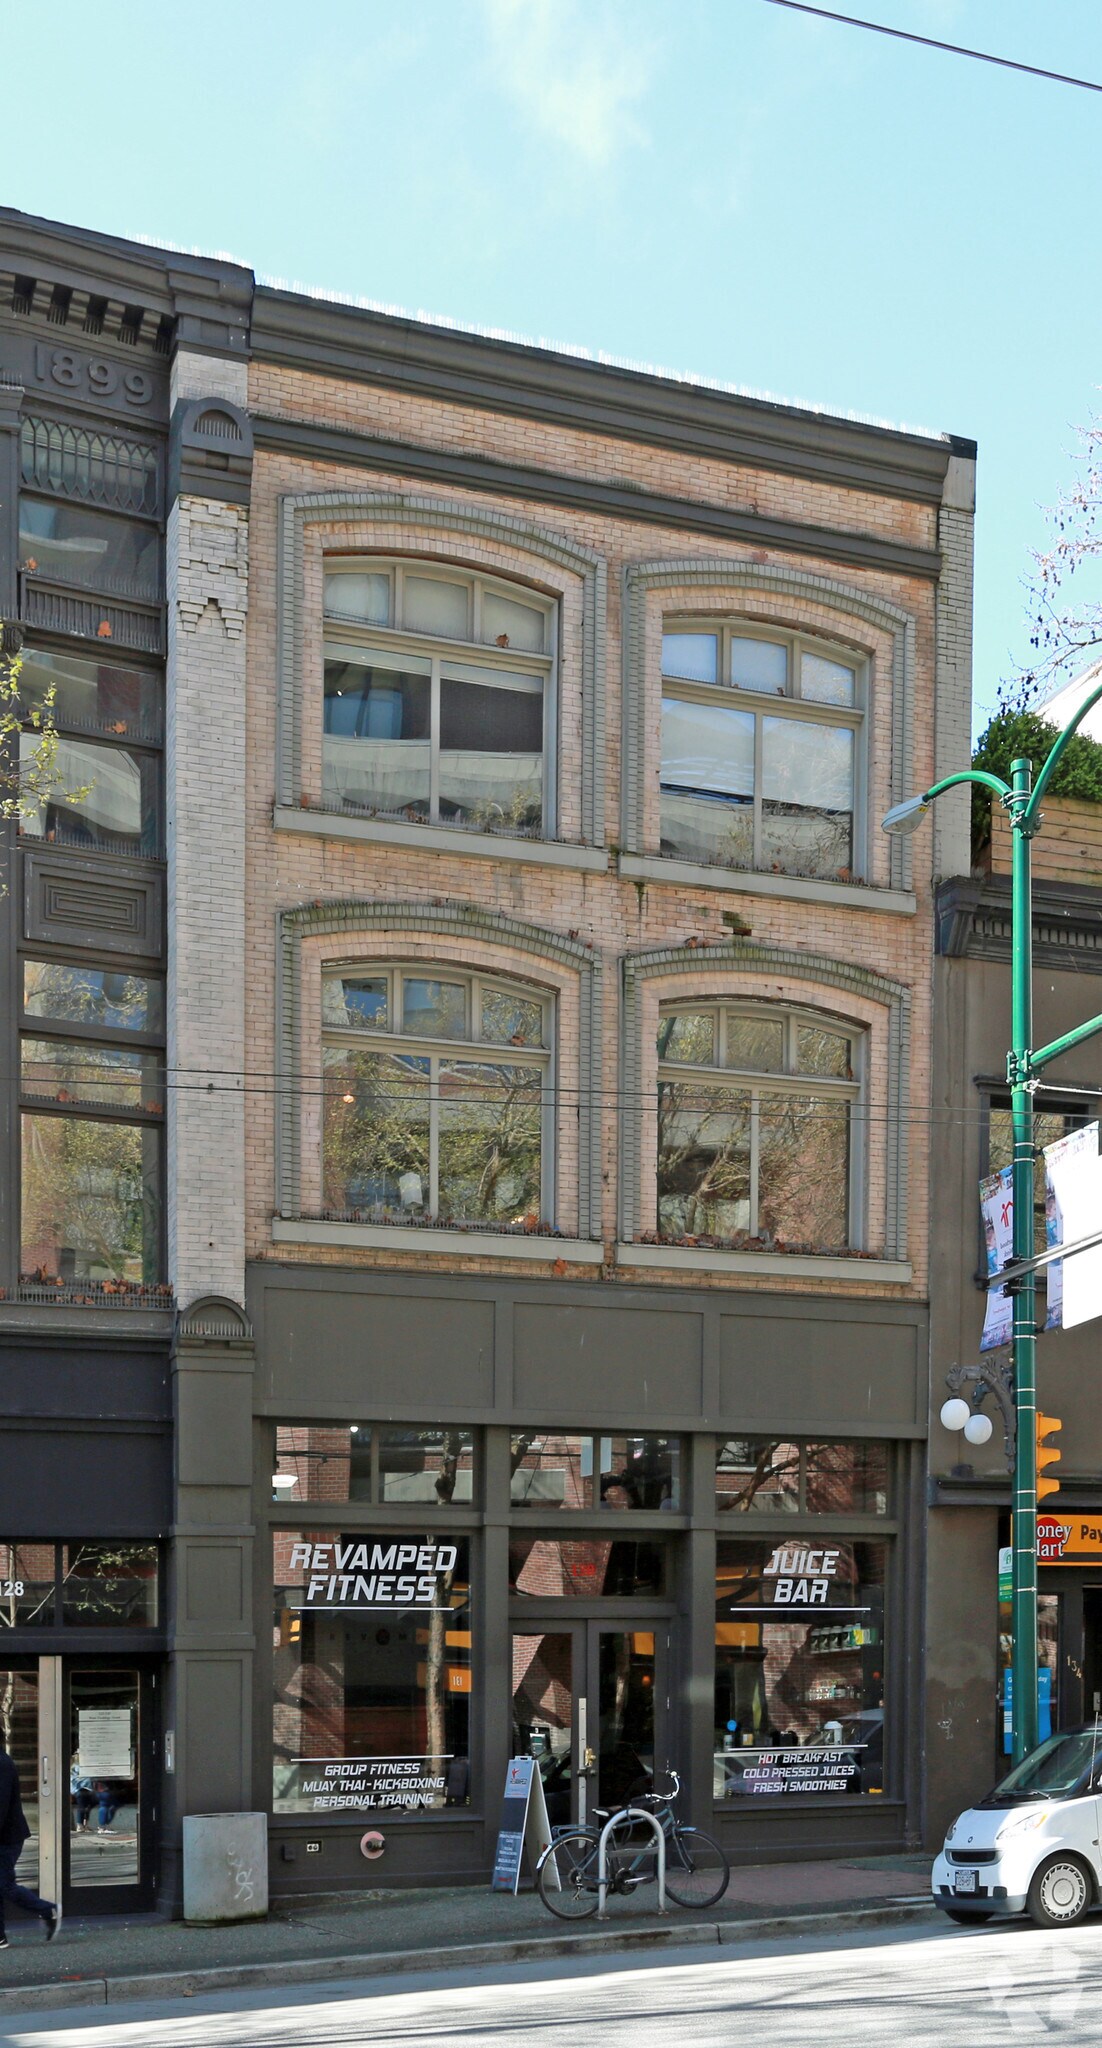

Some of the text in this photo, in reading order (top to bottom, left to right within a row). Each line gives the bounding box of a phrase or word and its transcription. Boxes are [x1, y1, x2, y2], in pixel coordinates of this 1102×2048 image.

[35, 345, 153, 405] 1899
[1037, 1525, 1072, 1544] oney
[289, 1543, 457, 1571] REVAMPED
[763, 1550, 840, 1574] JUICE
[306, 1575, 437, 1602] FITNESS
[773, 1579, 829, 1603] BAR
[1067, 1655, 1082, 1679] 134
[758, 1752, 843, 1764] HOT BREAKFAST
[324, 1763, 420, 1776] GROUP FITNESS
[742, 1765, 856, 1779] COLD PRESSED JUICES
[302, 1780, 337, 1792] MUAY
[753, 1780, 848, 1793] FRESH SMOOTHIES
[313, 1793, 435, 1808] PERSONAL TRAINING
